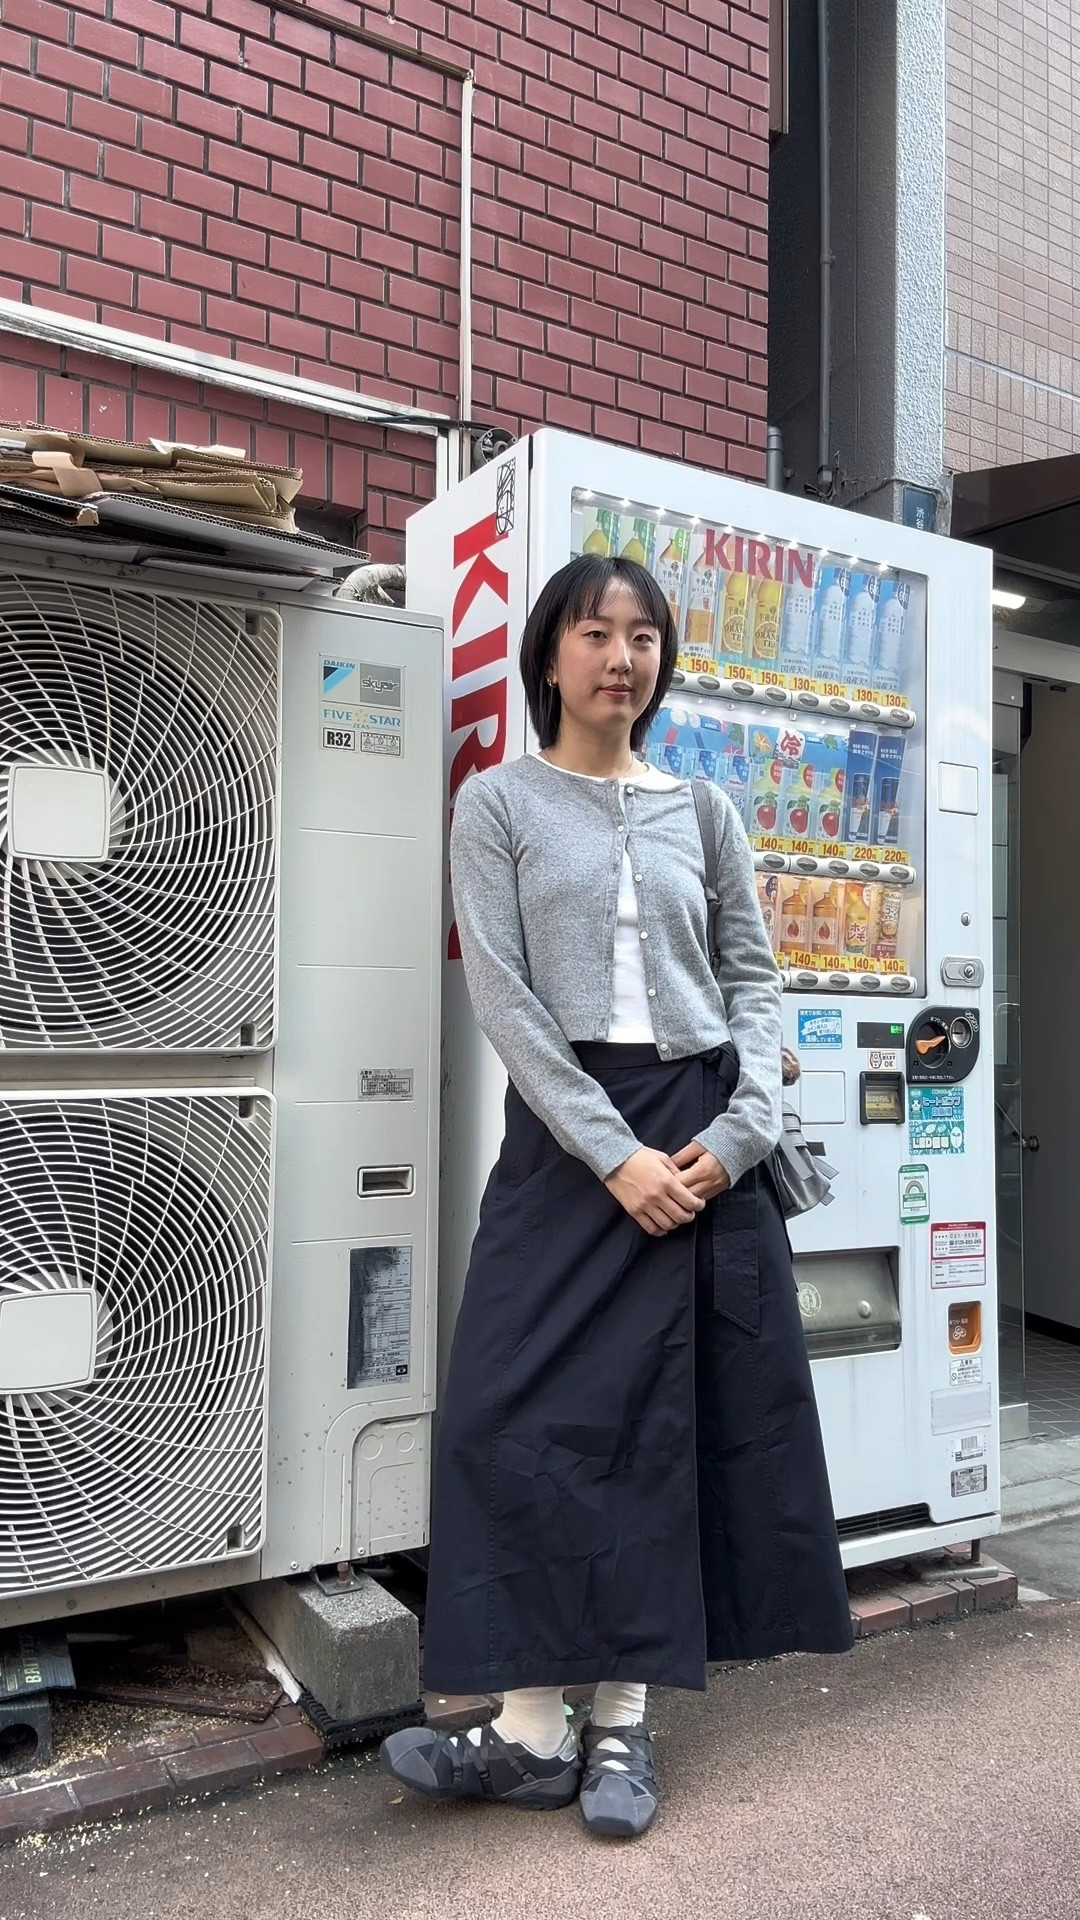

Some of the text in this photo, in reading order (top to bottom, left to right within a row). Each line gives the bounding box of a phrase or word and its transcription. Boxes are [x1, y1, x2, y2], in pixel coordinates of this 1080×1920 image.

[705, 528, 814, 588] KIRIN
[323, 659, 356, 669] DAIKIN
[323, 709, 401, 727] FIVE STAR
[326, 731, 352, 747] R32
[884, 1060, 894, 1068] OK
